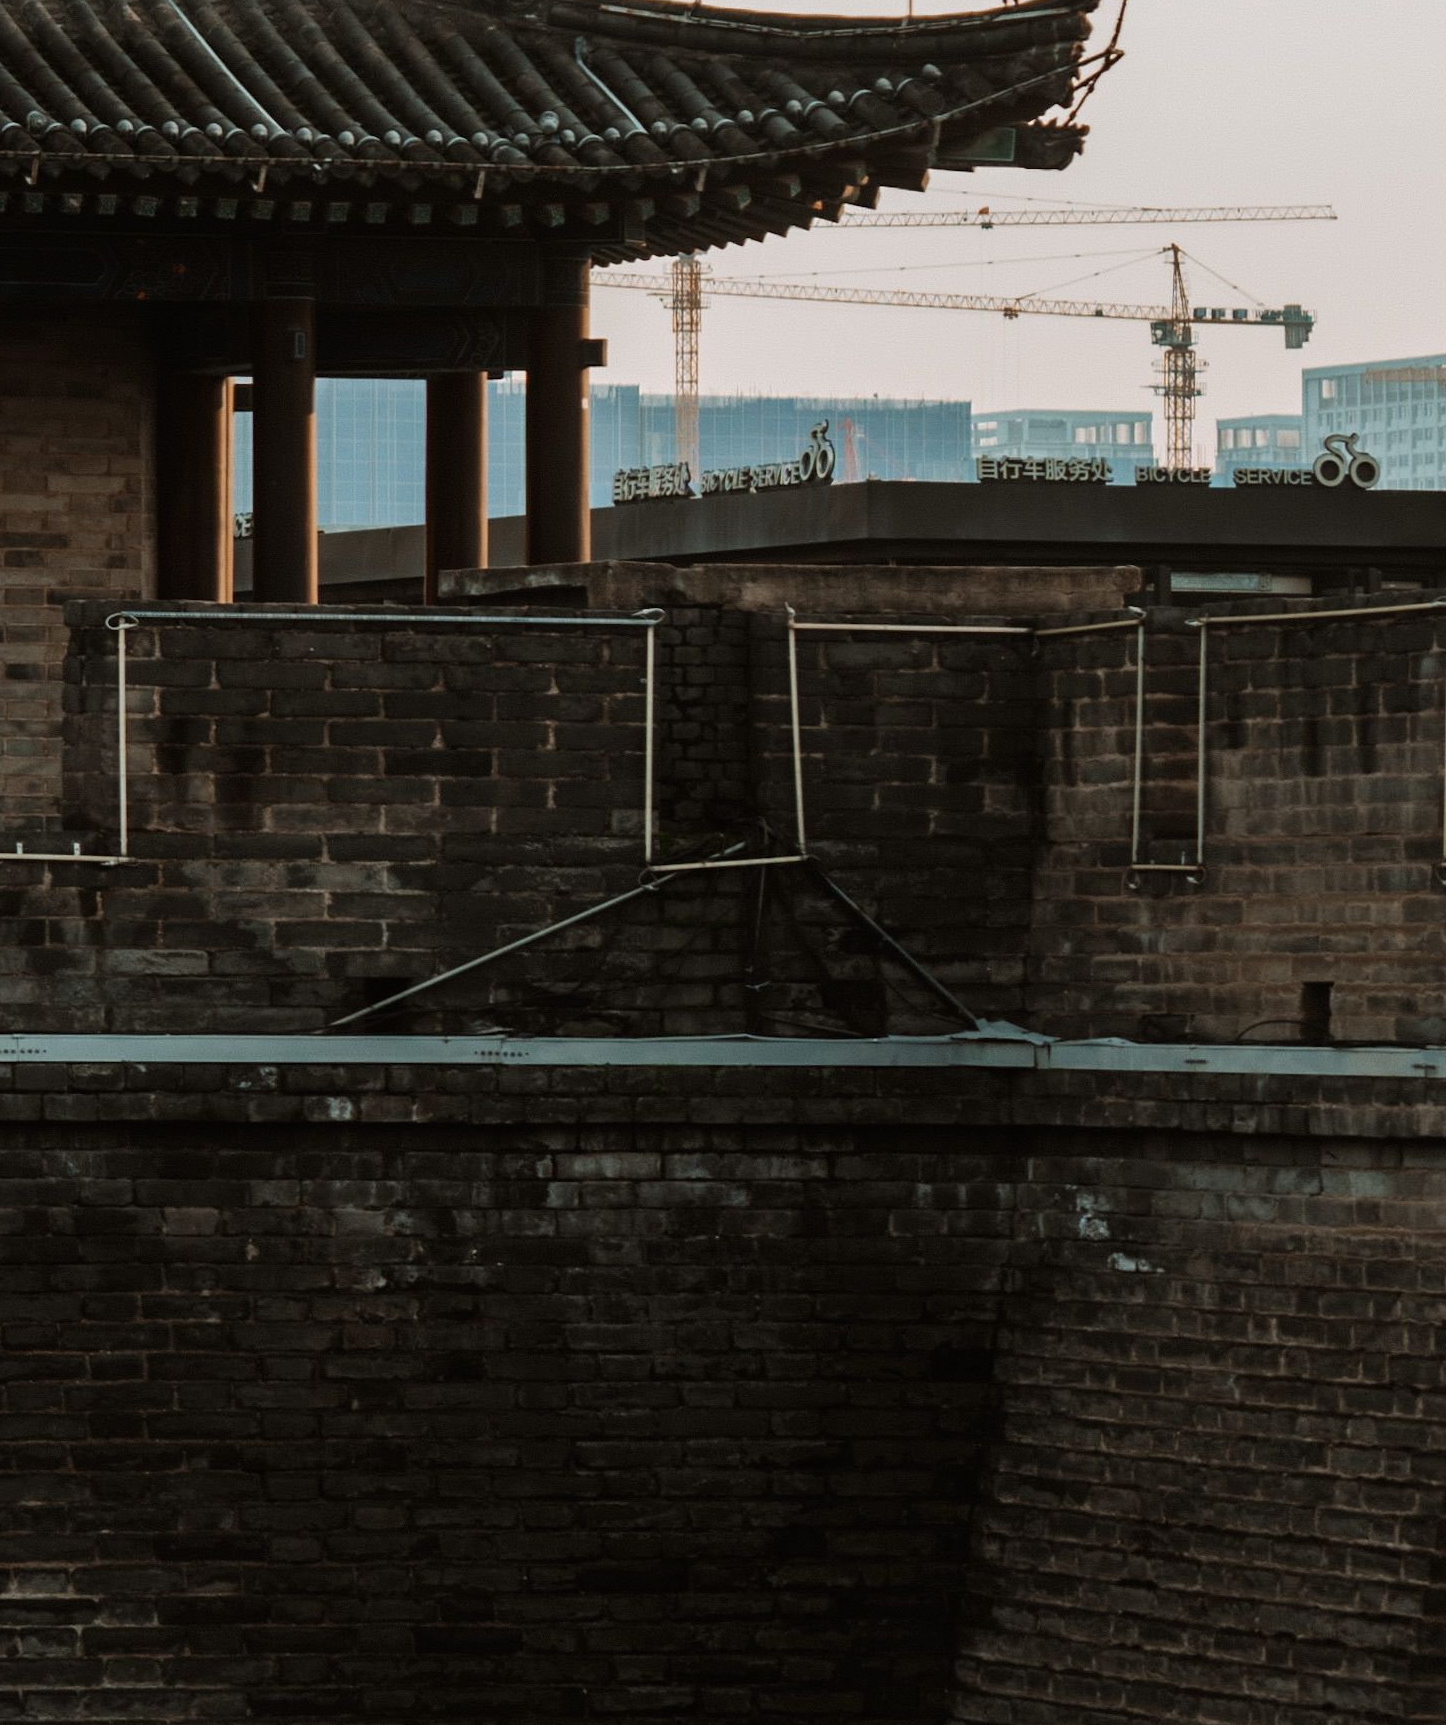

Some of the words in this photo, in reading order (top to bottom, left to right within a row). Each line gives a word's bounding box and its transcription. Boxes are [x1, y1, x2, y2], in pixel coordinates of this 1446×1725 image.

[613, 462, 692, 502] 自行车服务处
[701, 467, 751, 494] BICYCLE
[751, 461, 801, 489] SERVICE
[978, 456, 1114, 483] 自行车服务处
[1136, 465, 1211, 484] BICYCLE
[1234, 468, 1313, 486] SERVICE
